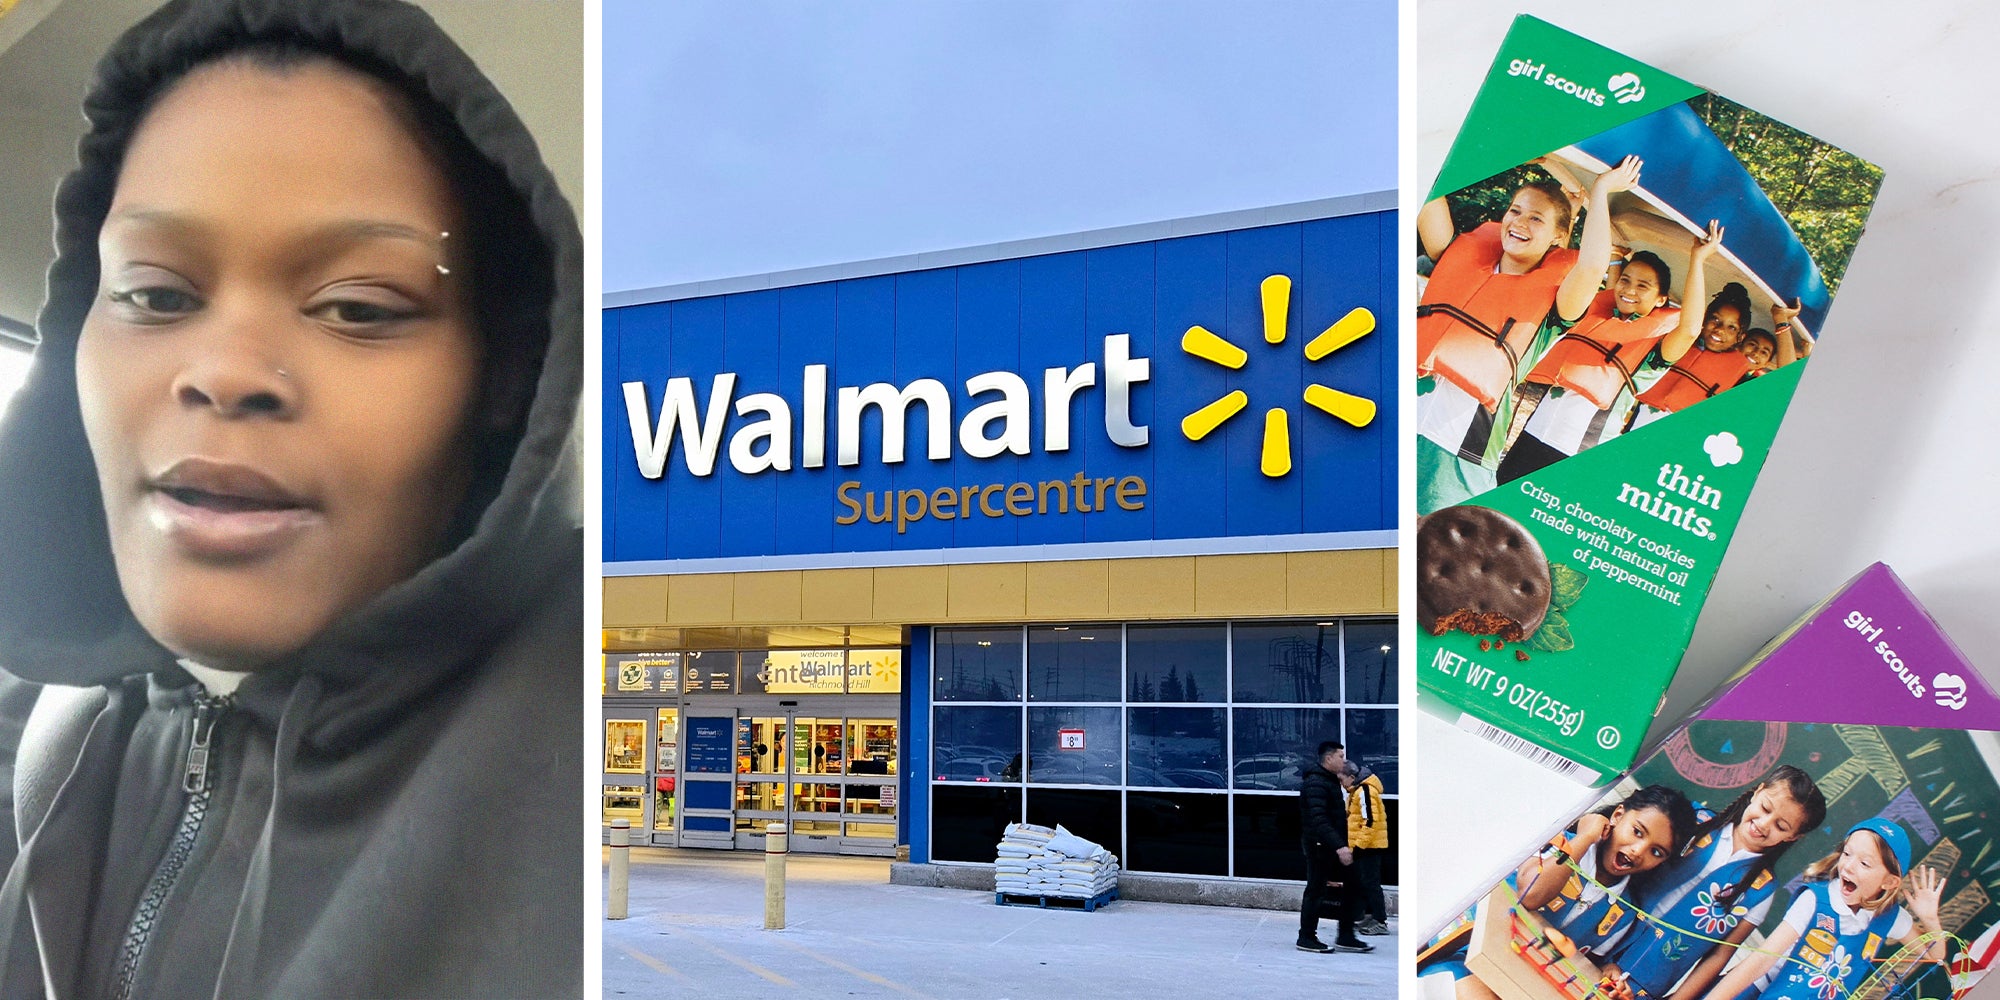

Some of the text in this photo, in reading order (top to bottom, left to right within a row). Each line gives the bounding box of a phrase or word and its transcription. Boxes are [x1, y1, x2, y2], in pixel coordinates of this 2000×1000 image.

[1507, 58, 1606, 107] girl scouts
[621, 333, 1151, 481] Walmart
[836, 471, 1148, 534] Supercentre
[1656, 463, 1722, 511] thin
[1520, 481, 1697, 569] Crisp, chocolaty cookies
[1530, 507, 1689, 587] made with natural oil
[1573, 548, 1682, 606] of peppermint.
[761, 662, 820, 684] Enter
[800, 661, 872, 676] Walmart
[1431, 647, 1468, 678] NET
[1465, 662, 1496, 691] WT
[1492, 676, 1509, 698] 9
[1843, 610, 1926, 699] girl scouts
[856, 679, 871, 689] Hill
